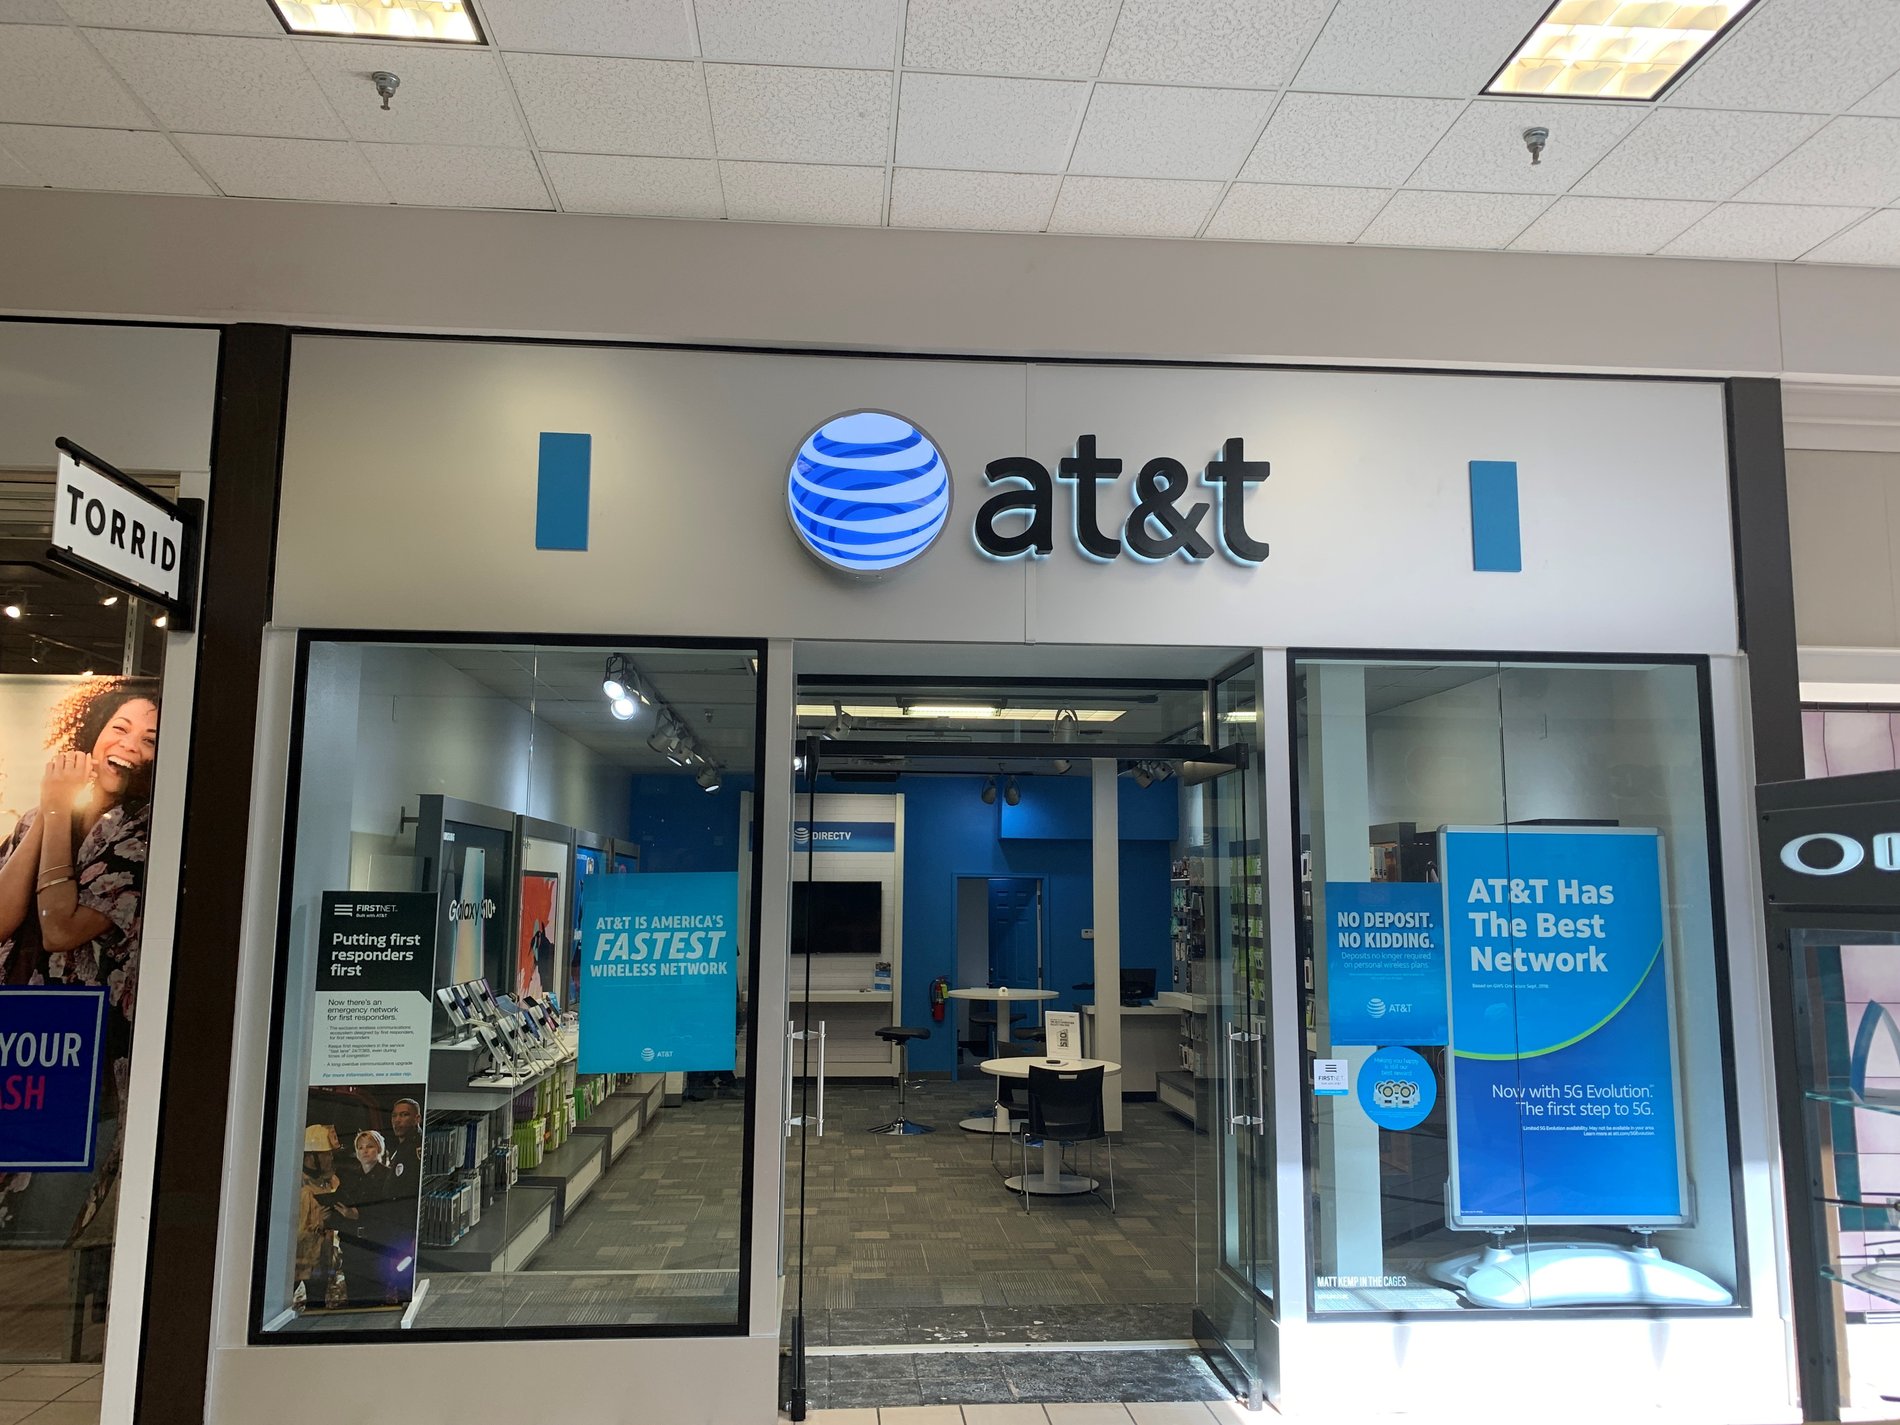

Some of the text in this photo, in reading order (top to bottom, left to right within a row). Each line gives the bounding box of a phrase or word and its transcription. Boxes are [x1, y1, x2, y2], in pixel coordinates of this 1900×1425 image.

[973, 434, 1270, 562] at&t
[67, 484, 177, 572] TORRID
[812, 832, 851, 841] DIRECTV
[1467, 879, 1614, 904] AT&T Has
[449, 898, 496, 925] Galaxy S10+
[596, 916, 632, 930] AT&T
[635, 916, 648, 929] IS
[1338, 912, 1434, 928] NO DEPOSIT.
[1468, 910, 1606, 938] The Best
[333, 932, 421, 948] Putting first
[594, 930, 727, 961] FASTEST
[1339, 932, 1435, 948] NO KIDDING.
[331, 948, 414, 963] responders
[1341, 952, 1371, 960] Deposits
[1381, 952, 1403, 961] longer
[1404, 952, 1431, 961] required
[1470, 946, 1608, 972] Network
[330, 963, 362, 976] first
[590, 962, 728, 977] WIRELESS NETWORK
[1354, 961, 1383, 969] personal
[1384, 961, 1410, 969] wireless
[1389, 1003, 1412, 1013] AT&T
[0, 1032, 82, 1067] YOUR
[657, 1050, 674, 1058] AT&T
[0, 1074, 46, 1110] SH
[1492, 1084, 1525, 1098] Now
[1529, 1084, 1561, 1098] with
[1564, 1084, 1583, 1098] 5G
[1516, 1101, 1655, 1119] The first step to 5G.
[1317, 1275, 1407, 1287] MATT KEMP IN THE CAGES
